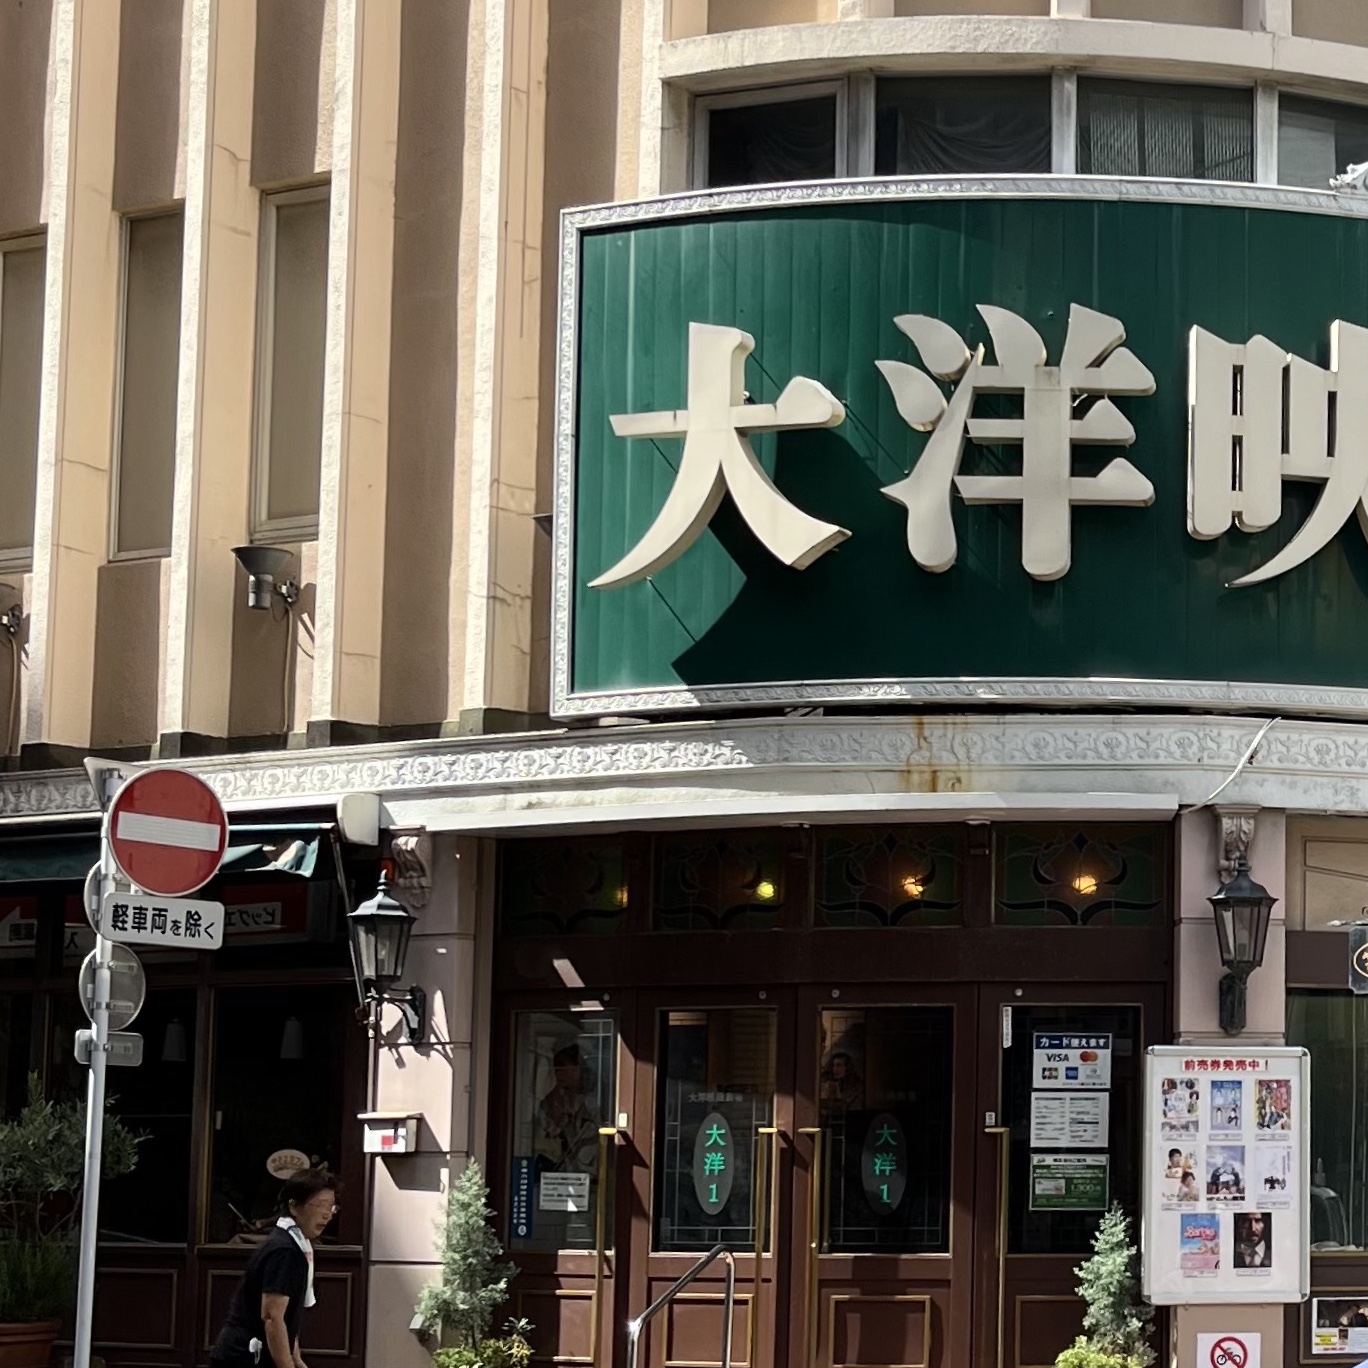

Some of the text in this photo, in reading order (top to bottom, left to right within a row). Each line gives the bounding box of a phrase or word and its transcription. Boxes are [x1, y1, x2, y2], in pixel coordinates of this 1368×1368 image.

[111, 903, 215, 939] 軽車両を除く
[1040, 1037, 1106, 1047] カード使えます
[1046, 1053, 1069, 1062] VISA
[704, 1124, 726, 1202] 大洋1
[873, 1124, 898, 1203] 大洋1
